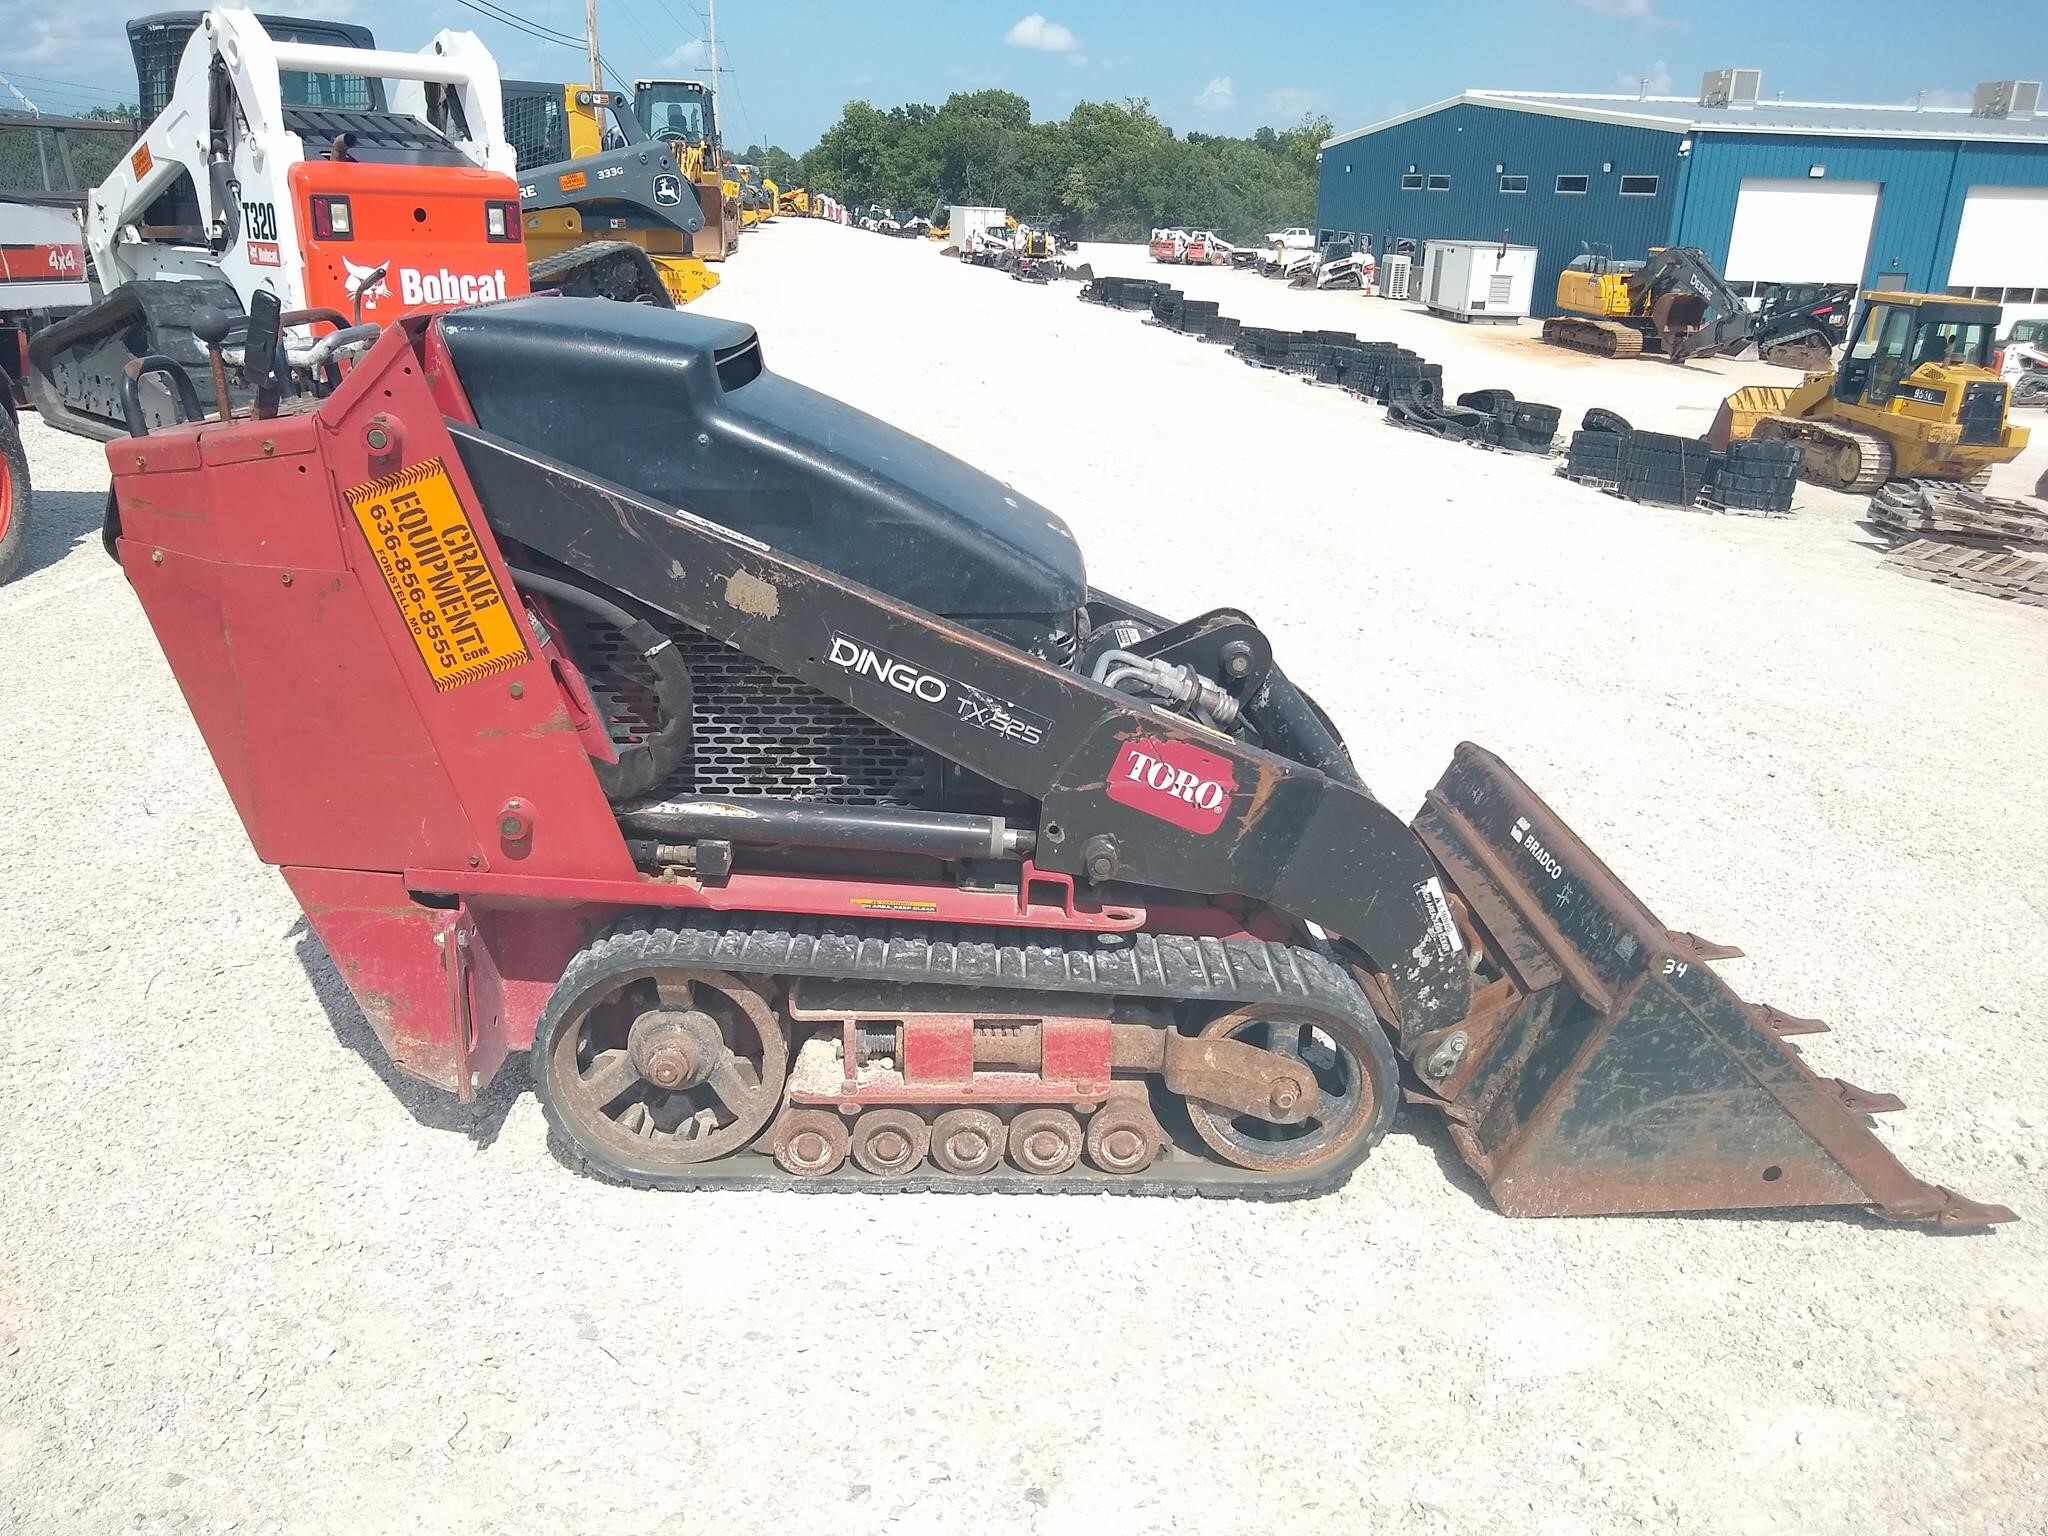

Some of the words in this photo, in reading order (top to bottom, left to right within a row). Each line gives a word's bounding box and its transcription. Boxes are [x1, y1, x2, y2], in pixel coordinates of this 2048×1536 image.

[597, 167, 624, 180] 333G
[242, 202, 277, 241] T320
[48, 249, 75, 271] 4x4
[399, 268, 507, 305] Bobcat
[1690, 273, 1713, 301] DEERE
[370, 504, 457, 668] 636-856-8555
[440, 524, 500, 611] CRAIG
[376, 549, 409, 615] FORISTELL,
[409, 617, 422, 636] MO
[829, 637, 947, 703] DINGO
[1125, 750, 1223, 810] TORO
[1524, 835, 1562, 880] BRADCO
[1662, 959, 1688, 978] 34
